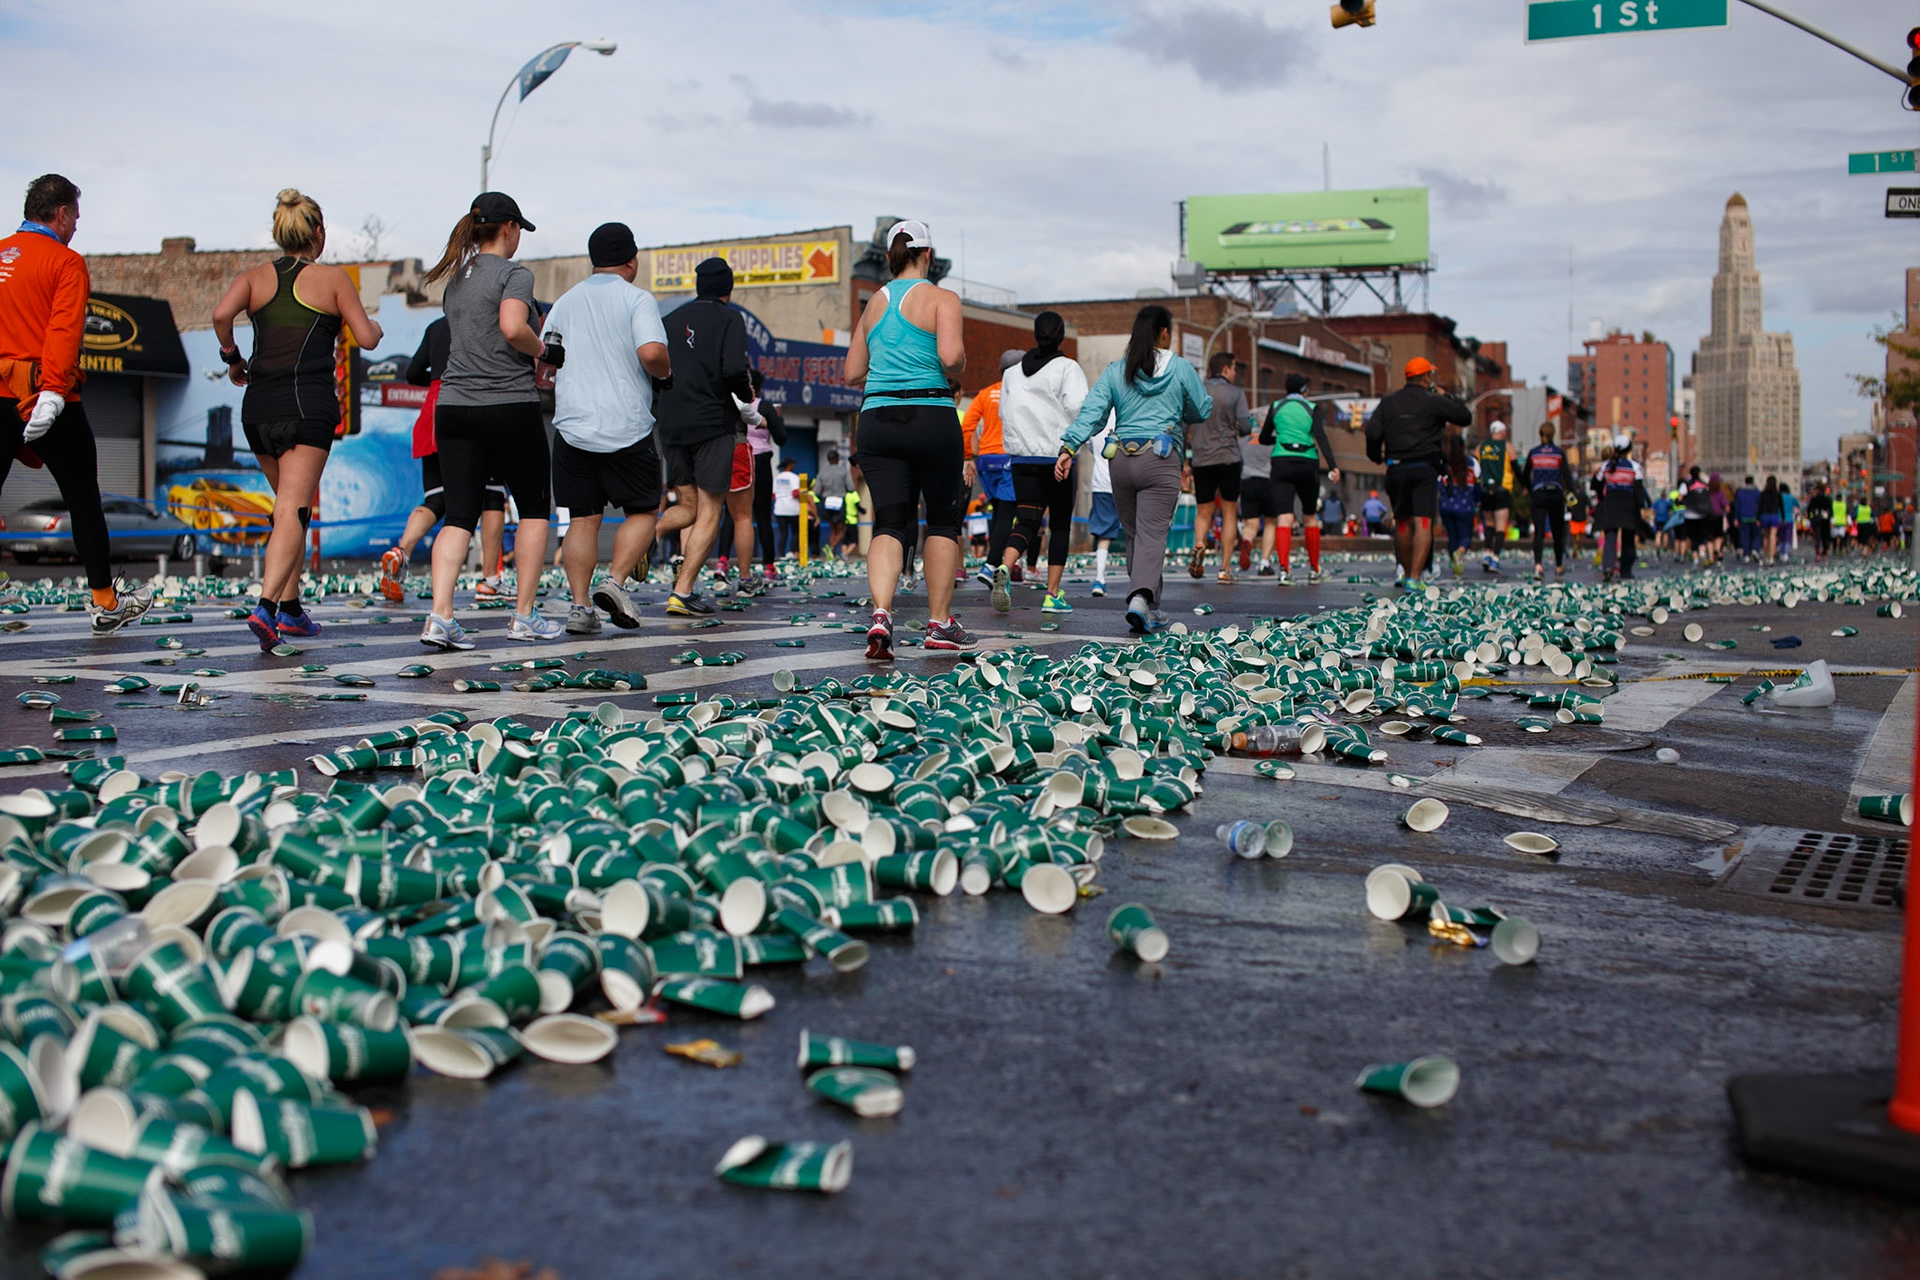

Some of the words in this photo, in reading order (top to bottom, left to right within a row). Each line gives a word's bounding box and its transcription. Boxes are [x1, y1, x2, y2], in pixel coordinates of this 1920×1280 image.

[1592, 3, 1602, 29] 1
[1618, 0, 1659, 27] St
[1874, 154, 1880, 172] 1
[1891, 151, 1906, 163] ST
[1898, 196, 1920, 209] ON
[729, 245, 803, 272] SUPPLIES
[79, 353, 123, 372] ENTER
[757, 355, 801, 382] PAINT
[387, 387, 429, 402] ENTRANC
